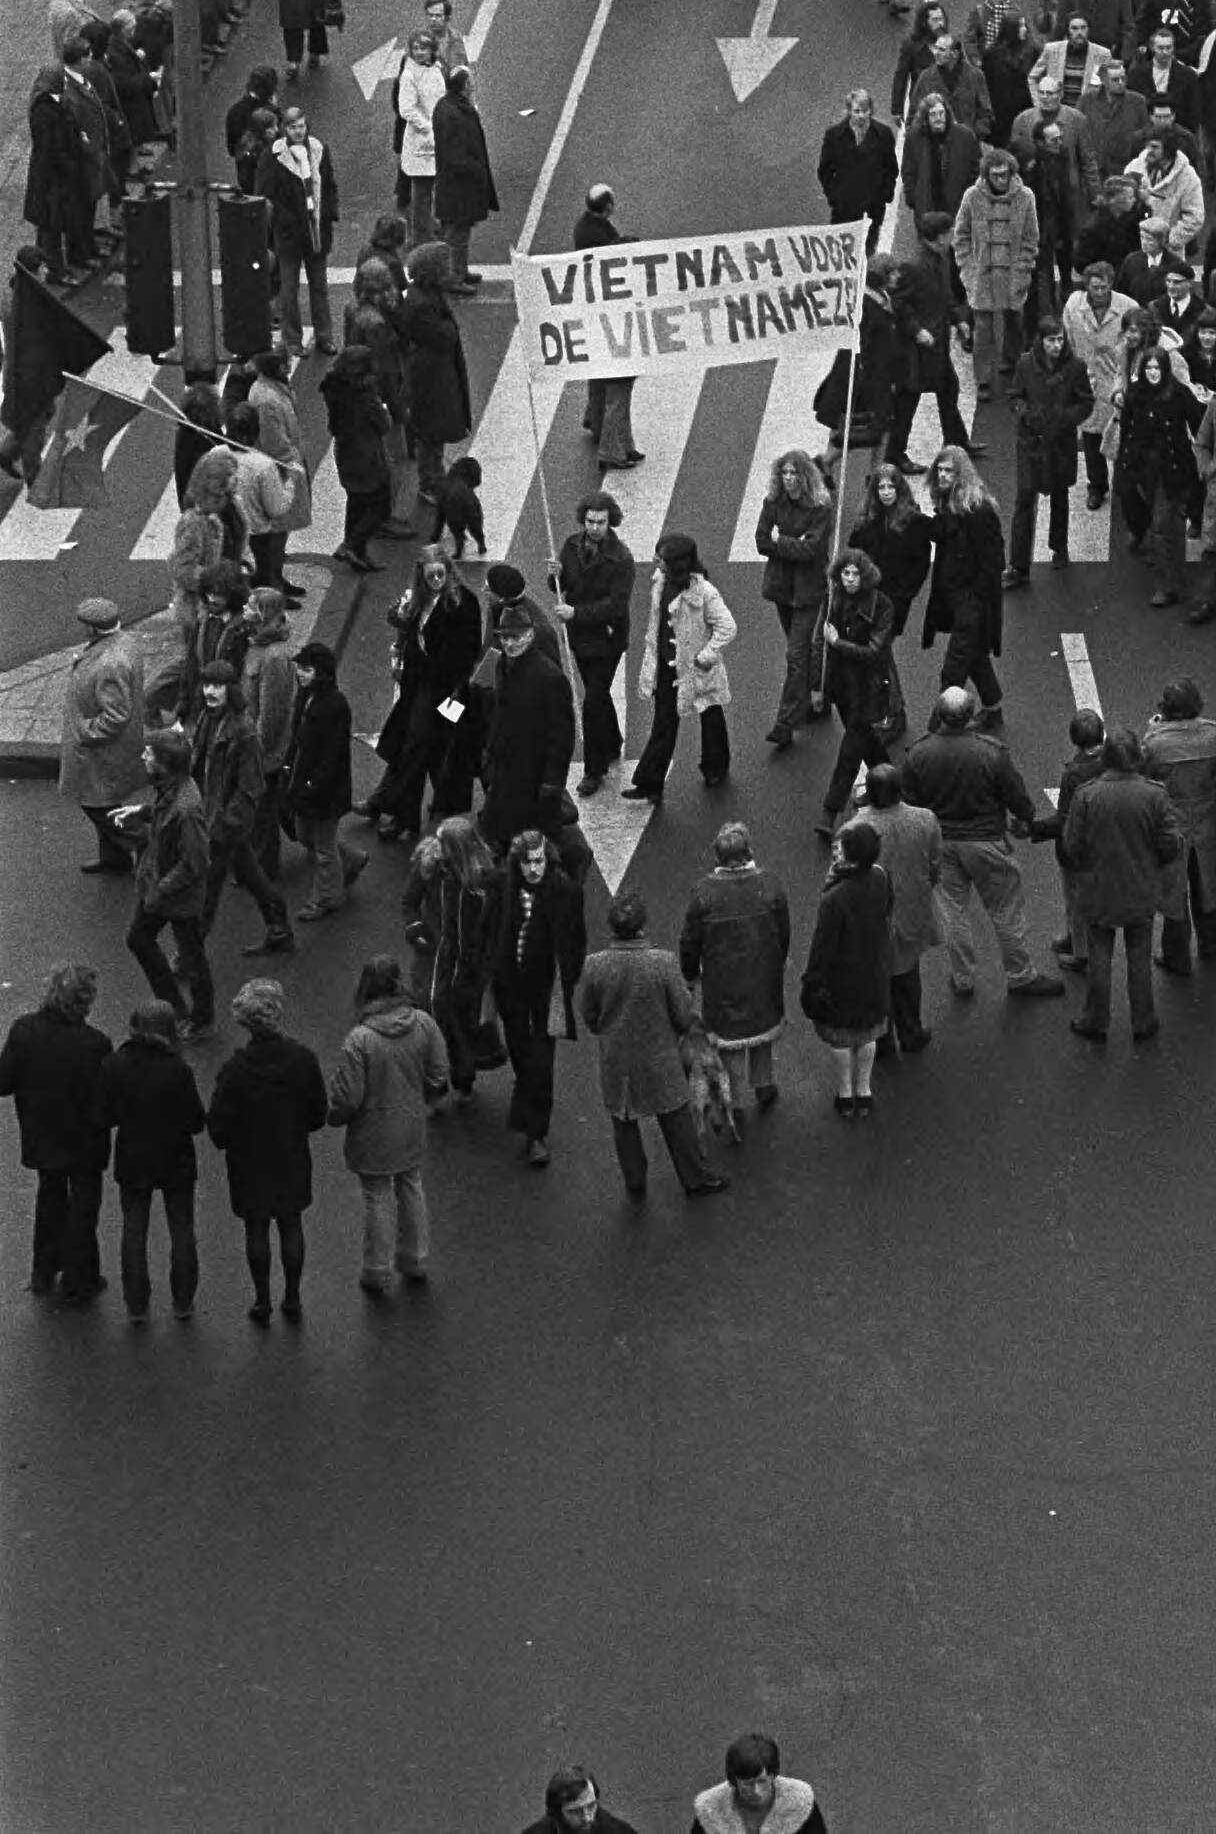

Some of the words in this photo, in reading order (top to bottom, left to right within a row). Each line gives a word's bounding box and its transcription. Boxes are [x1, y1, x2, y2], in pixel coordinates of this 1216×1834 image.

[541, 237, 784, 307] VIETNAM
[788, 232, 858, 275] VOOR
[539, 319, 590, 366] DE
